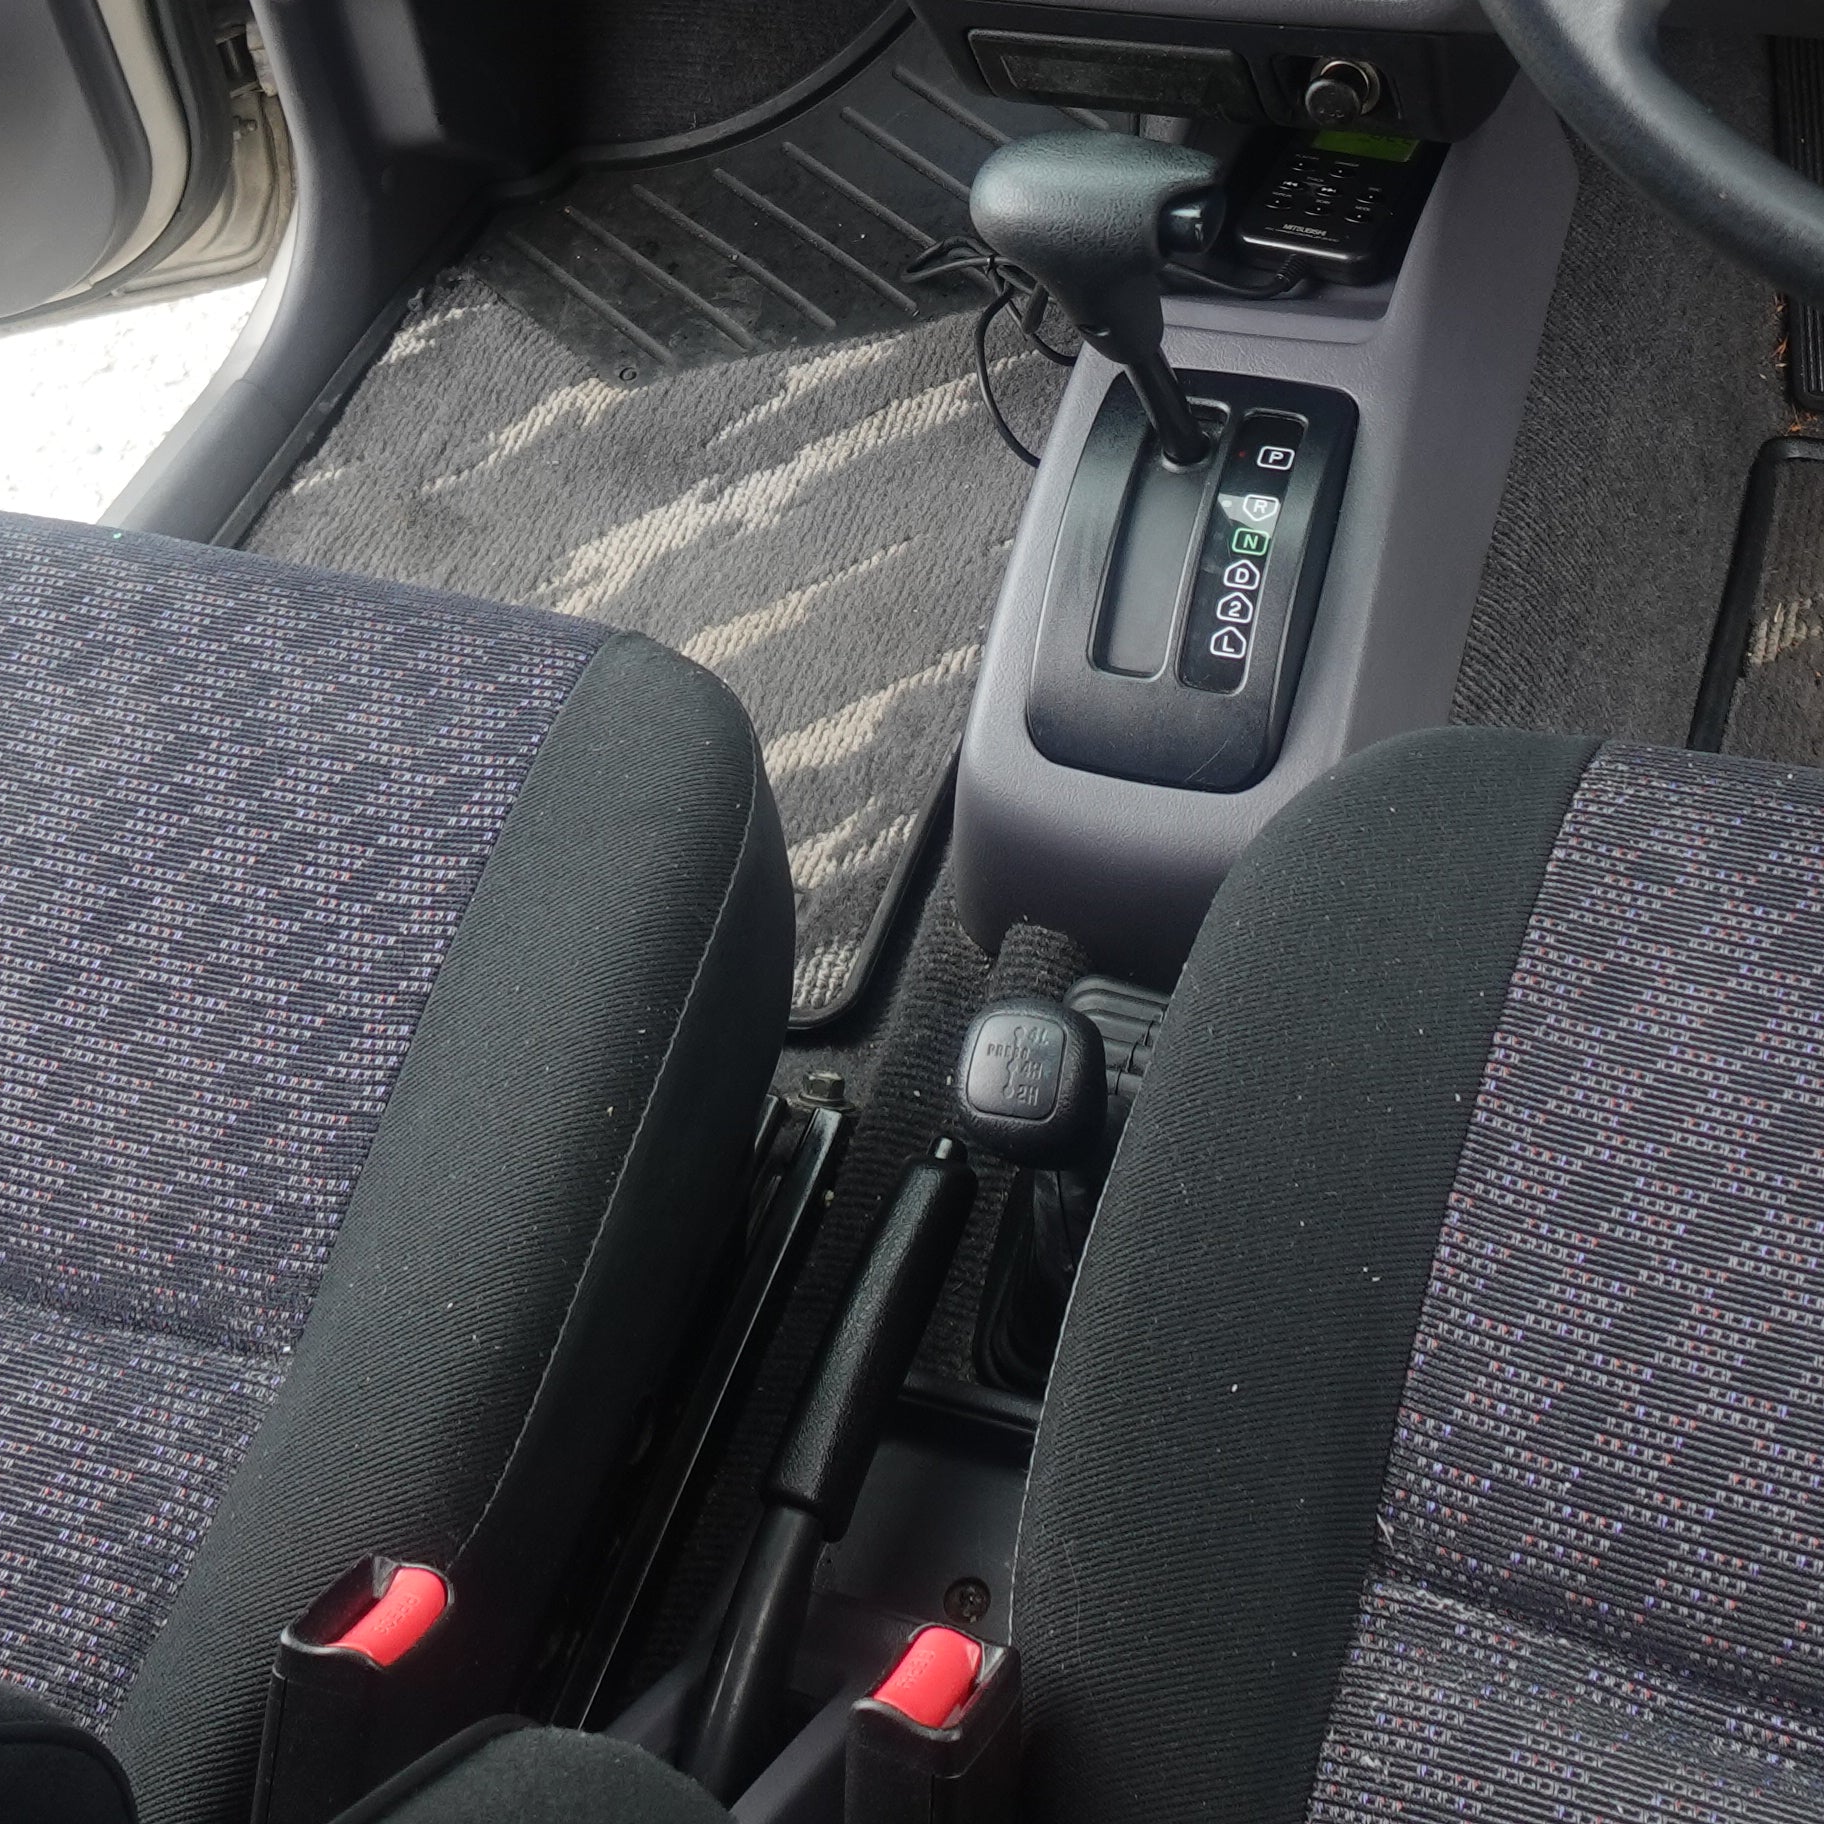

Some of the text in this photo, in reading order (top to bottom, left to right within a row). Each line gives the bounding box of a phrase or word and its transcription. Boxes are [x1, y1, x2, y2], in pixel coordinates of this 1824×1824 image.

[1282, 223, 1327, 237] MITSUBISHI
[1268, 450, 1284, 464] P
[1253, 499, 1268, 514] R
[1244, 534, 1258, 549] N
[1234, 568, 1249, 583] D
[1228, 601, 1241, 617] 2
[1222, 636, 1235, 652] L
[1016, 1083, 1040, 1106] 2H
